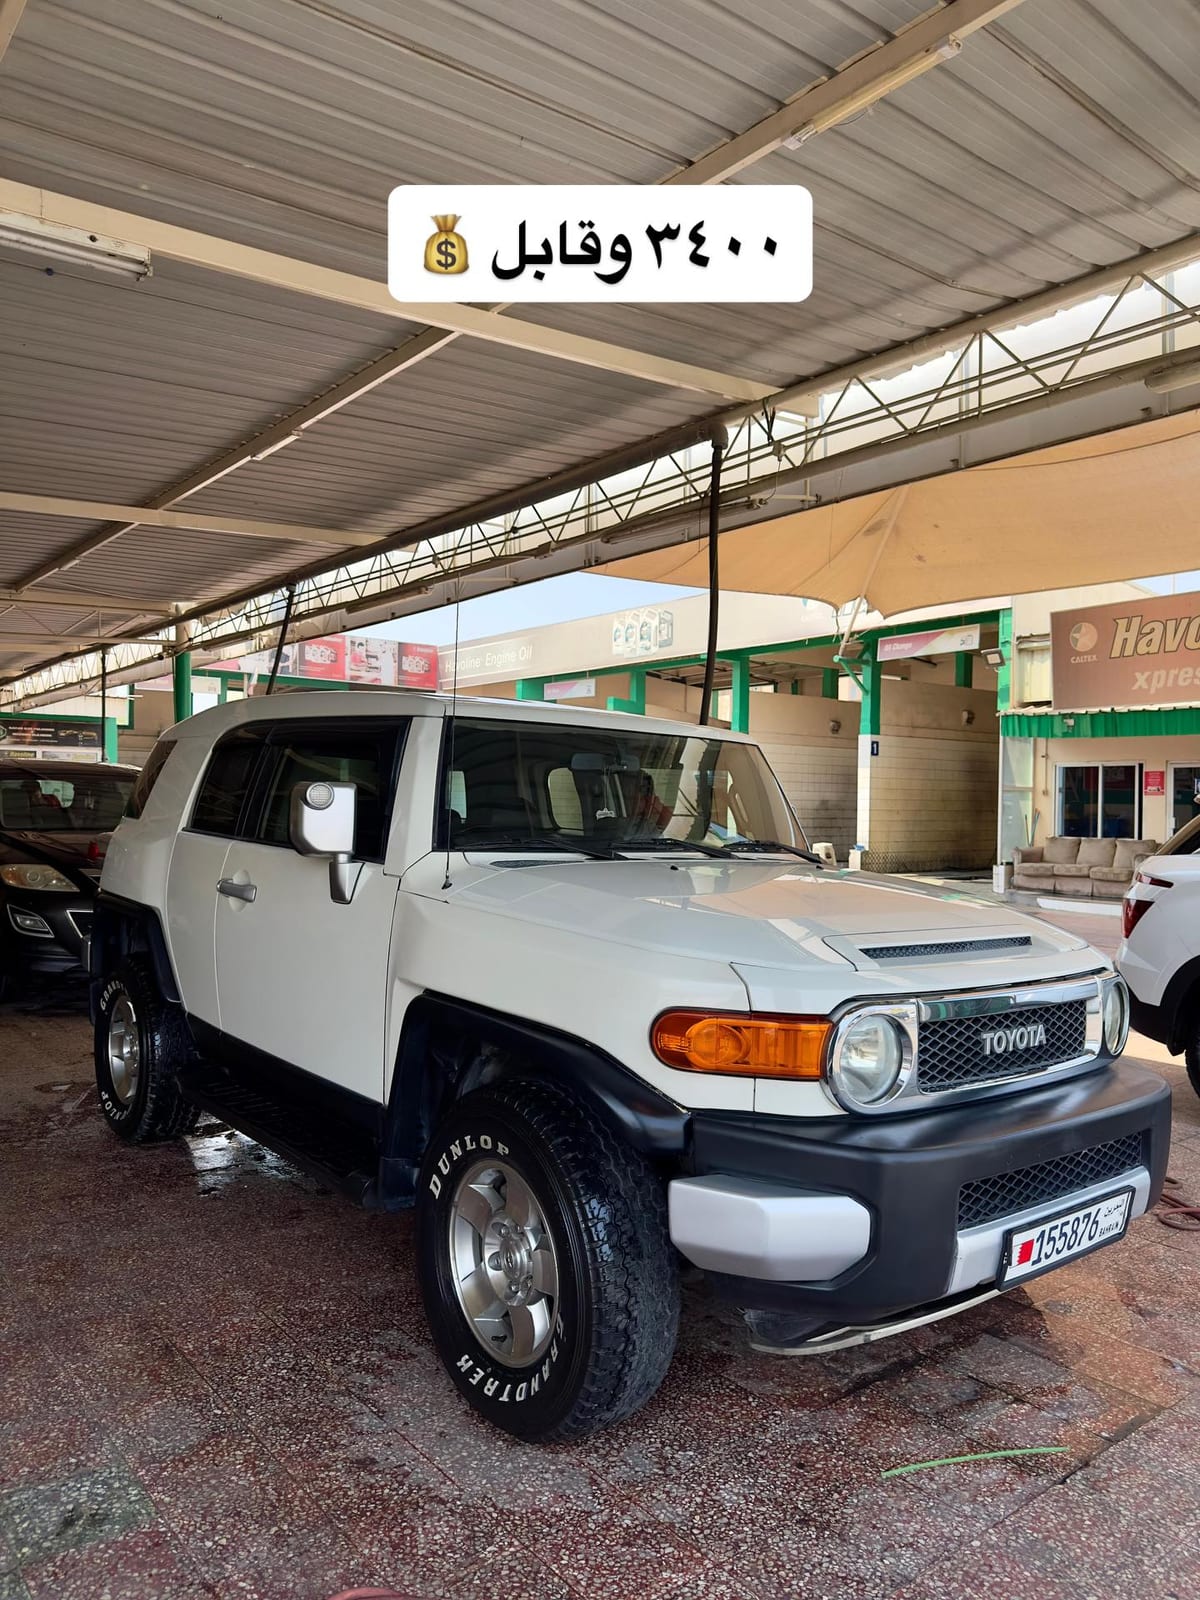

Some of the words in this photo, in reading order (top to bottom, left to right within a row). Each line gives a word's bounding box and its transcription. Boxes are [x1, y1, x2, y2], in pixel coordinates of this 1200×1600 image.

[485, 649, 517, 667] Engine
[519, 644, 533, 661] Oil
[1070, 654, 1098, 664] CALTEX
[982, 1024, 1047, 1056] TOYOTA
[429, 1134, 509, 1200] DUNLOP
[1031, 1208, 1101, 1266] 155876
